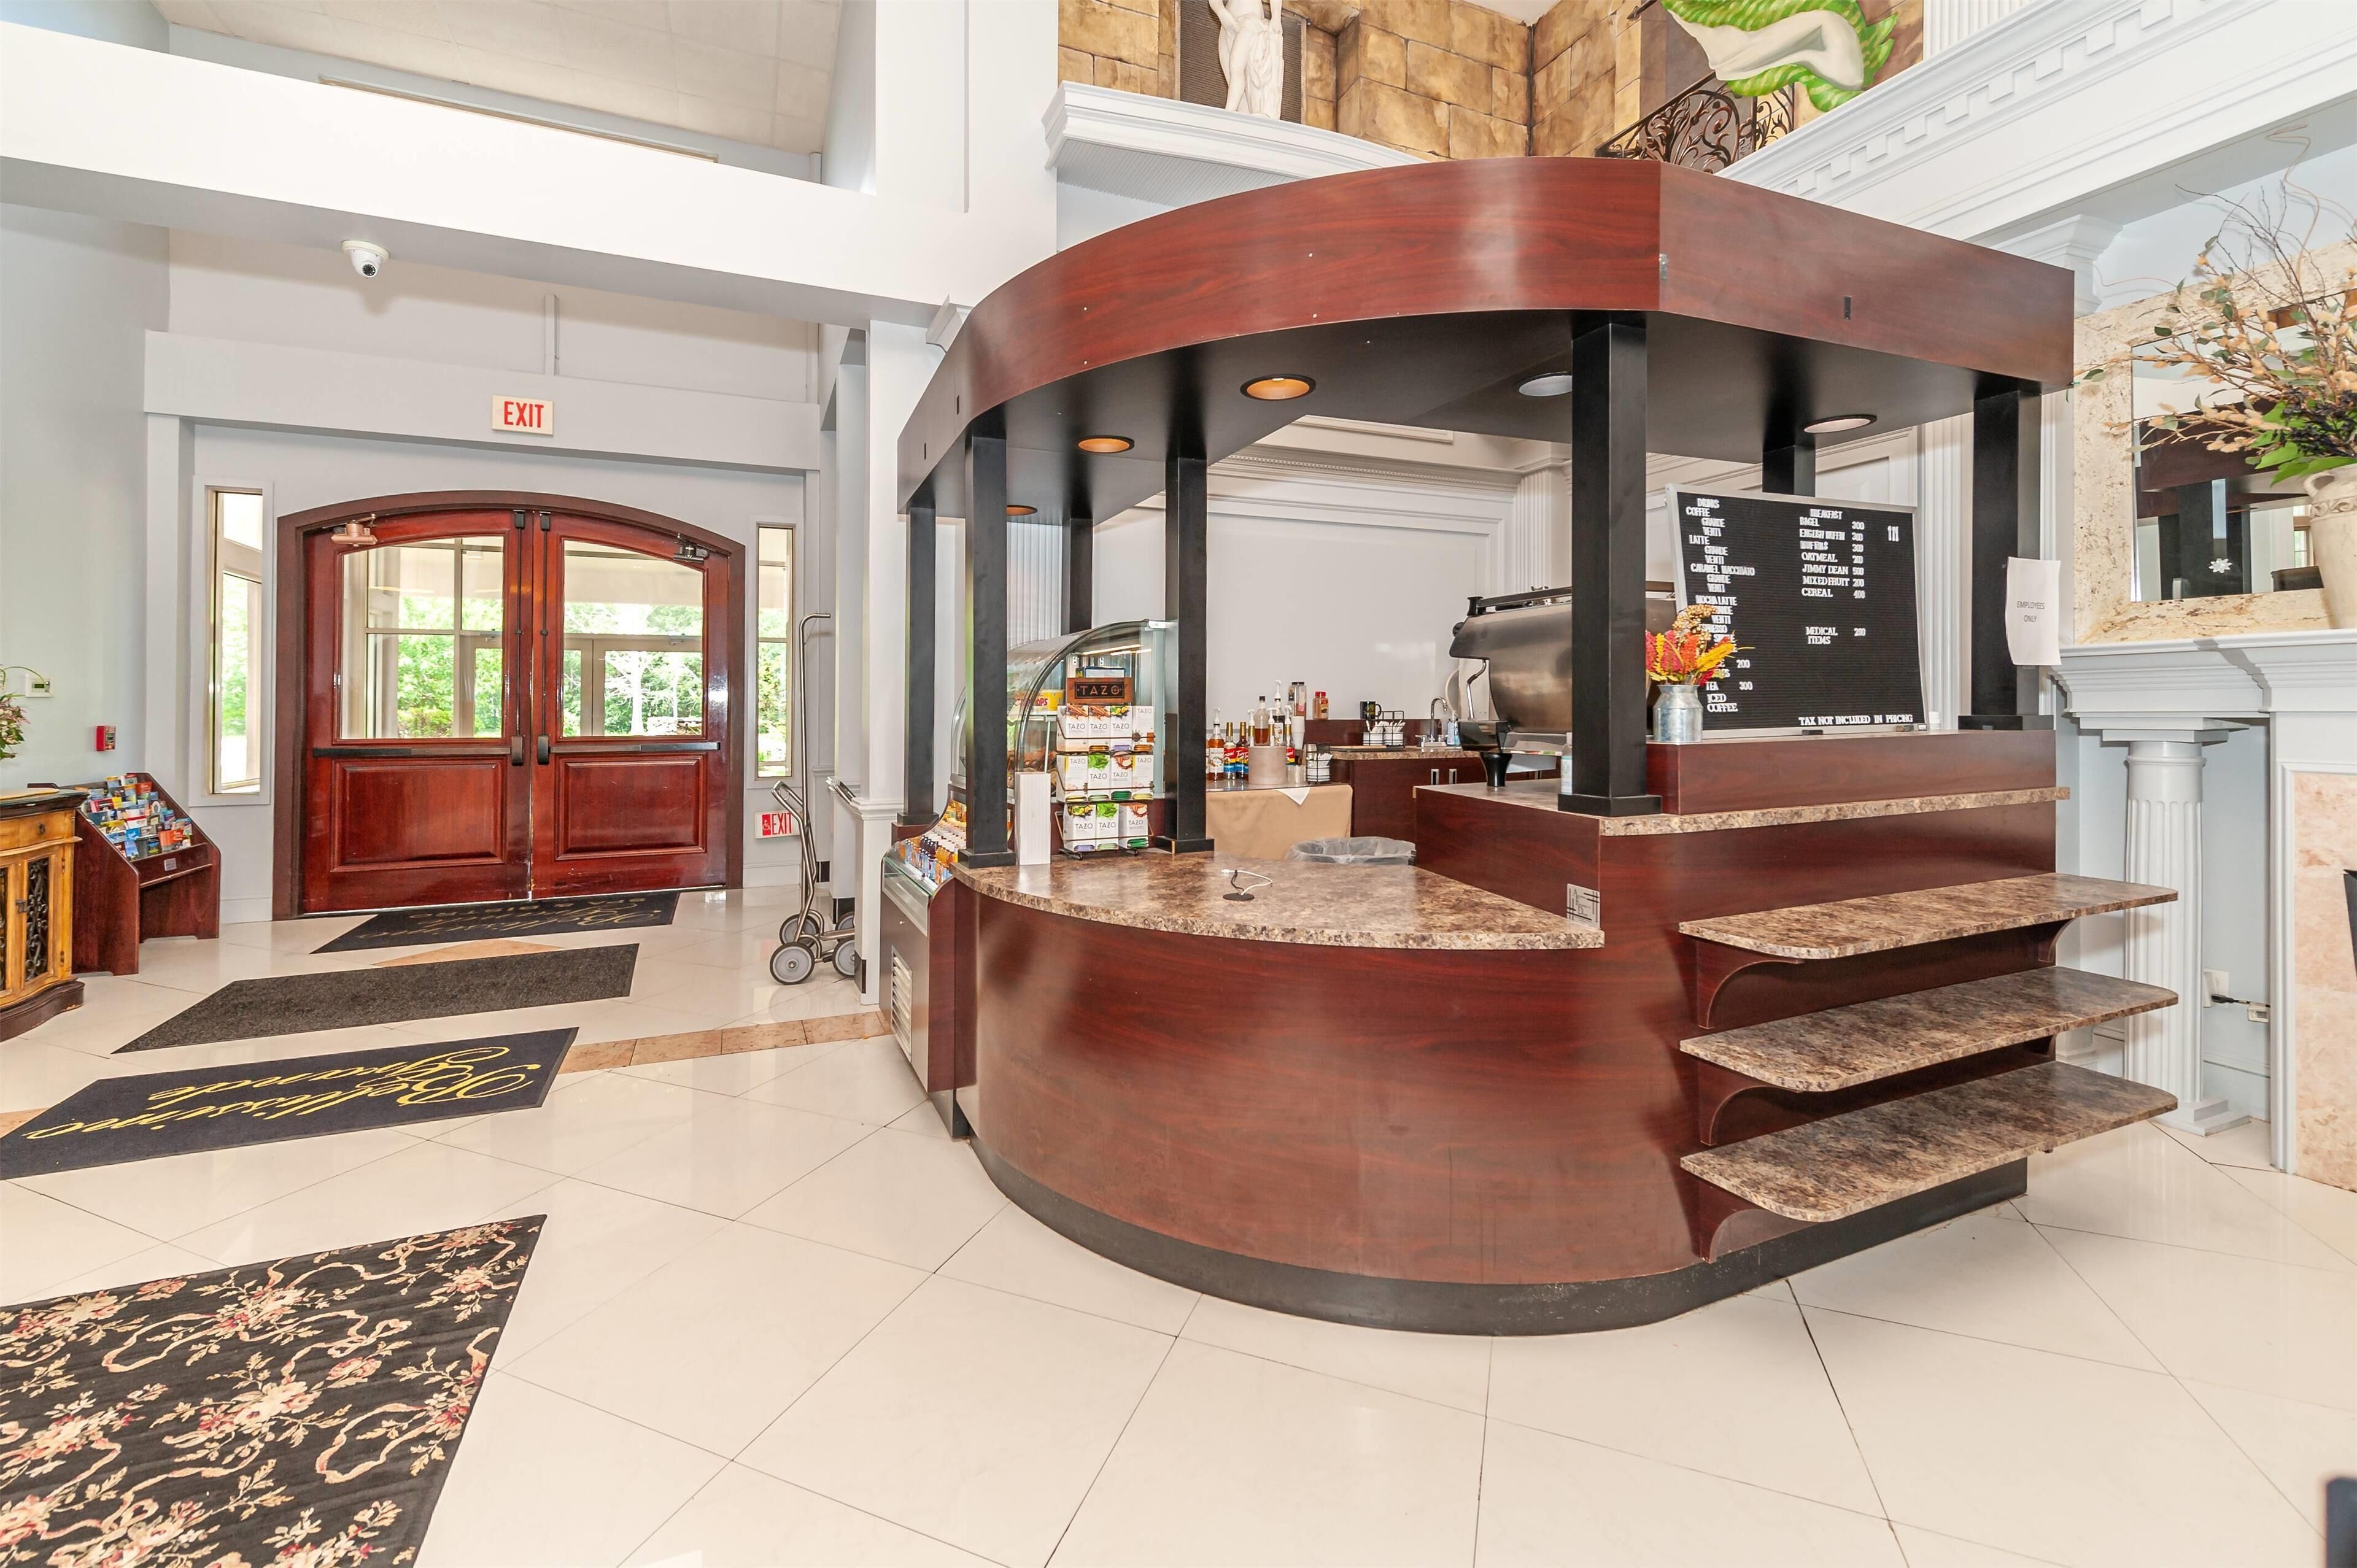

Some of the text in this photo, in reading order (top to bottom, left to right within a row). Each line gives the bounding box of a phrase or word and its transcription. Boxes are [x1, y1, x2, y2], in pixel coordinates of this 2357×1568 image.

[504, 401, 544, 428] EXIT
[1686, 506, 1711, 517] COFFEE
[1810, 509, 1843, 520] BREAKFAST
[1800, 516, 1865, 530] BAGEL 300
[1800, 528, 1825, 539] ENGLISH
[1689, 535, 1711, 545] LATTE
[1801, 552, 1838, 563] OATMEAL
[1690, 563, 1720, 574] CARAMEL
[1802, 564, 1865, 576] JIMMY DEAN 500
[1802, 576, 1865, 587] MIXED FRUIT 200
[1801, 588, 1833, 598] CEREAL
[1717, 596, 1738, 606] LATTE
[2016, 601, 2045, 609] EMPLOYEES
[1711, 615, 1732, 625] VENTI
[1805, 626, 1839, 636] MEDICAL
[1807, 636, 1832, 645] ITEMS
[1736, 658, 1751, 669] 200
[1079, 685, 1120, 696] TAZO
[1706, 681, 1754, 692] TEA 300
[1706, 693, 1727, 704] ICED
[1706, 702, 1739, 713] COFFEE
[1798, 714, 1914, 726] TAX NOT INCLUDED IN PRICING
[772, 813, 792, 835] EXIT
[147, 1046, 511, 1110] Grande
[21, 1064, 541, 1140] Bellissimo
